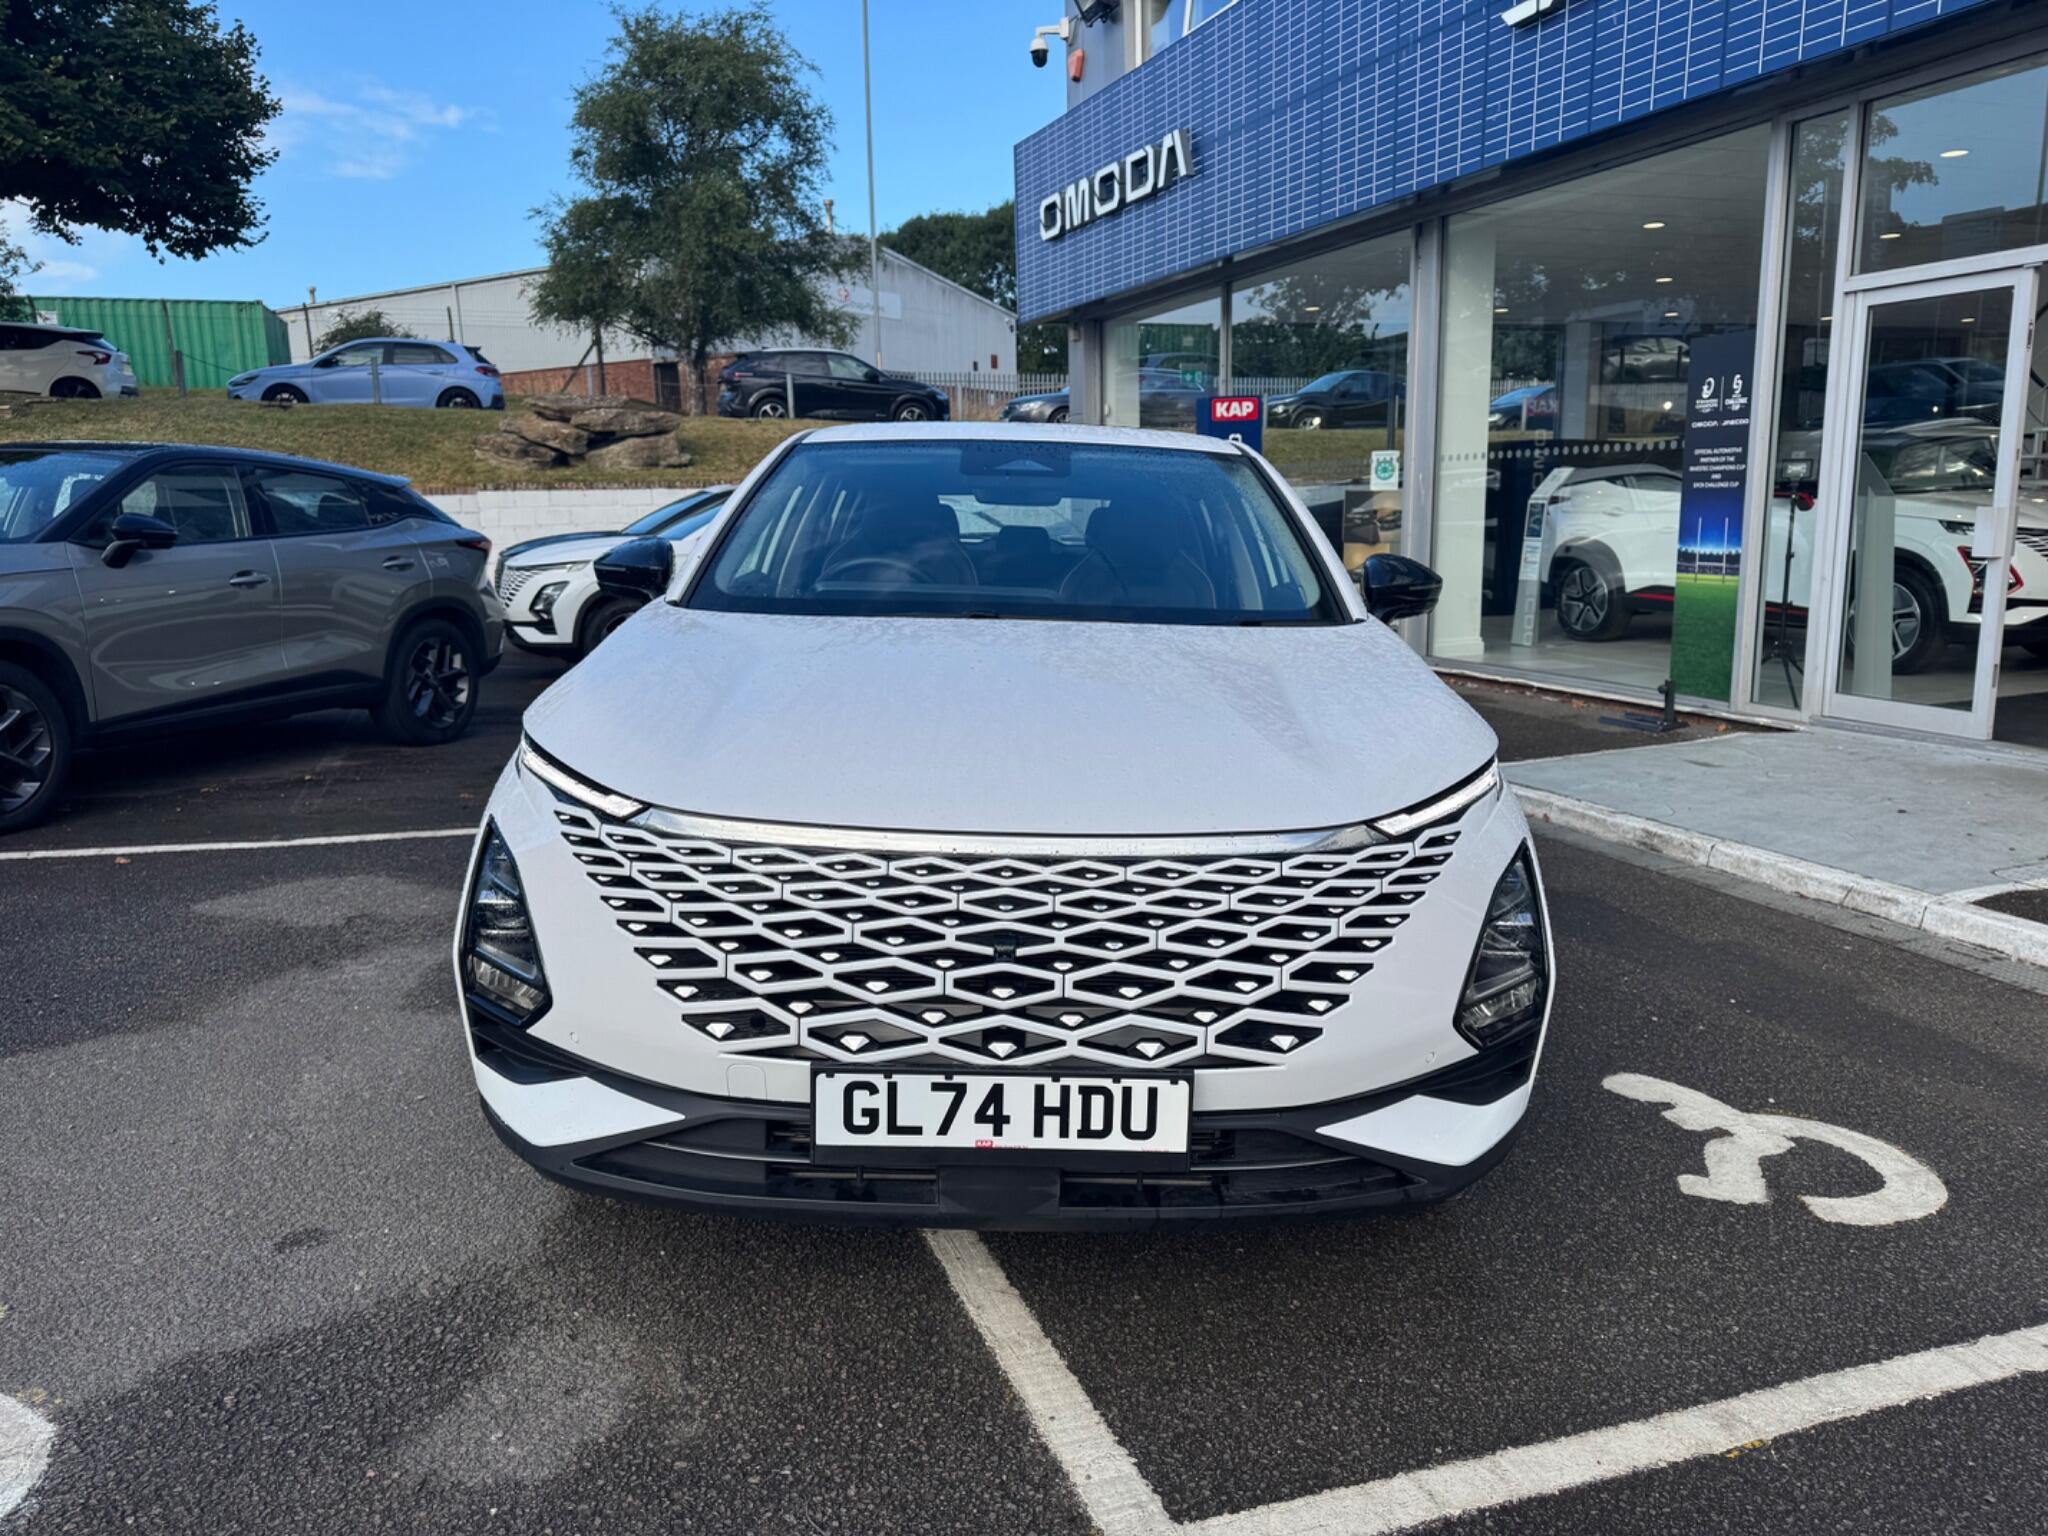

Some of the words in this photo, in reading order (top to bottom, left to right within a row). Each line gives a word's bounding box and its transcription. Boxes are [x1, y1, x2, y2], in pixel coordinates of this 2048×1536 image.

[1039, 128, 1189, 241] OMODA
[1215, 401, 1255, 418] KAP
[842, 1080, 1010, 1138] GL74
[1033, 1083, 1159, 1142] HDU
